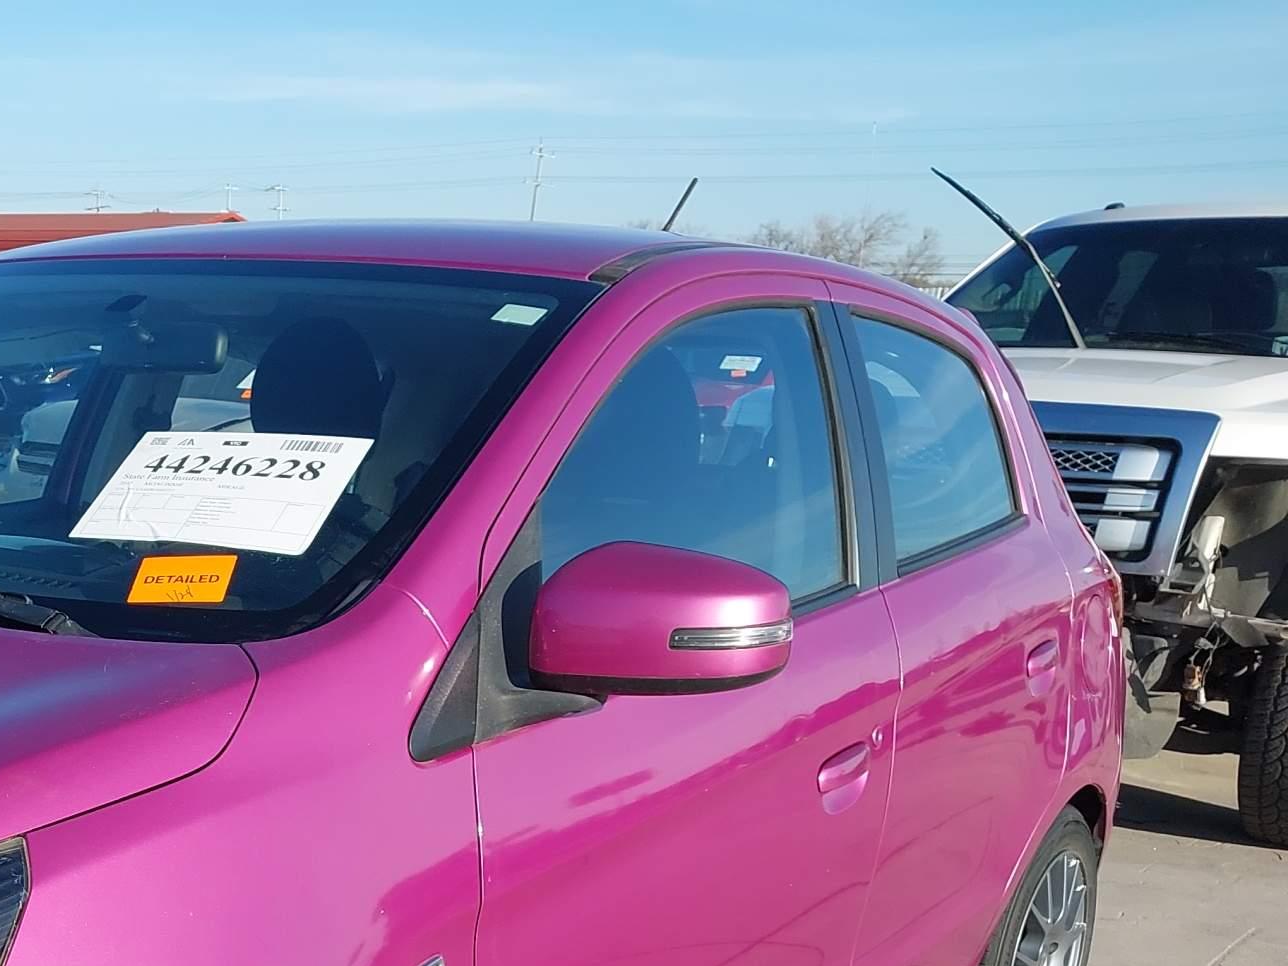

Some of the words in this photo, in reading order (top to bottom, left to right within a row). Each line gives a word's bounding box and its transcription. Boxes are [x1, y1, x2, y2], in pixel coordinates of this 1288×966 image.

[144, 453, 326, 481] 44246228
[147, 473, 170, 481] Farm
[172, 473, 215, 483] Insurance
[144, 574, 220, 584] DETAILED
